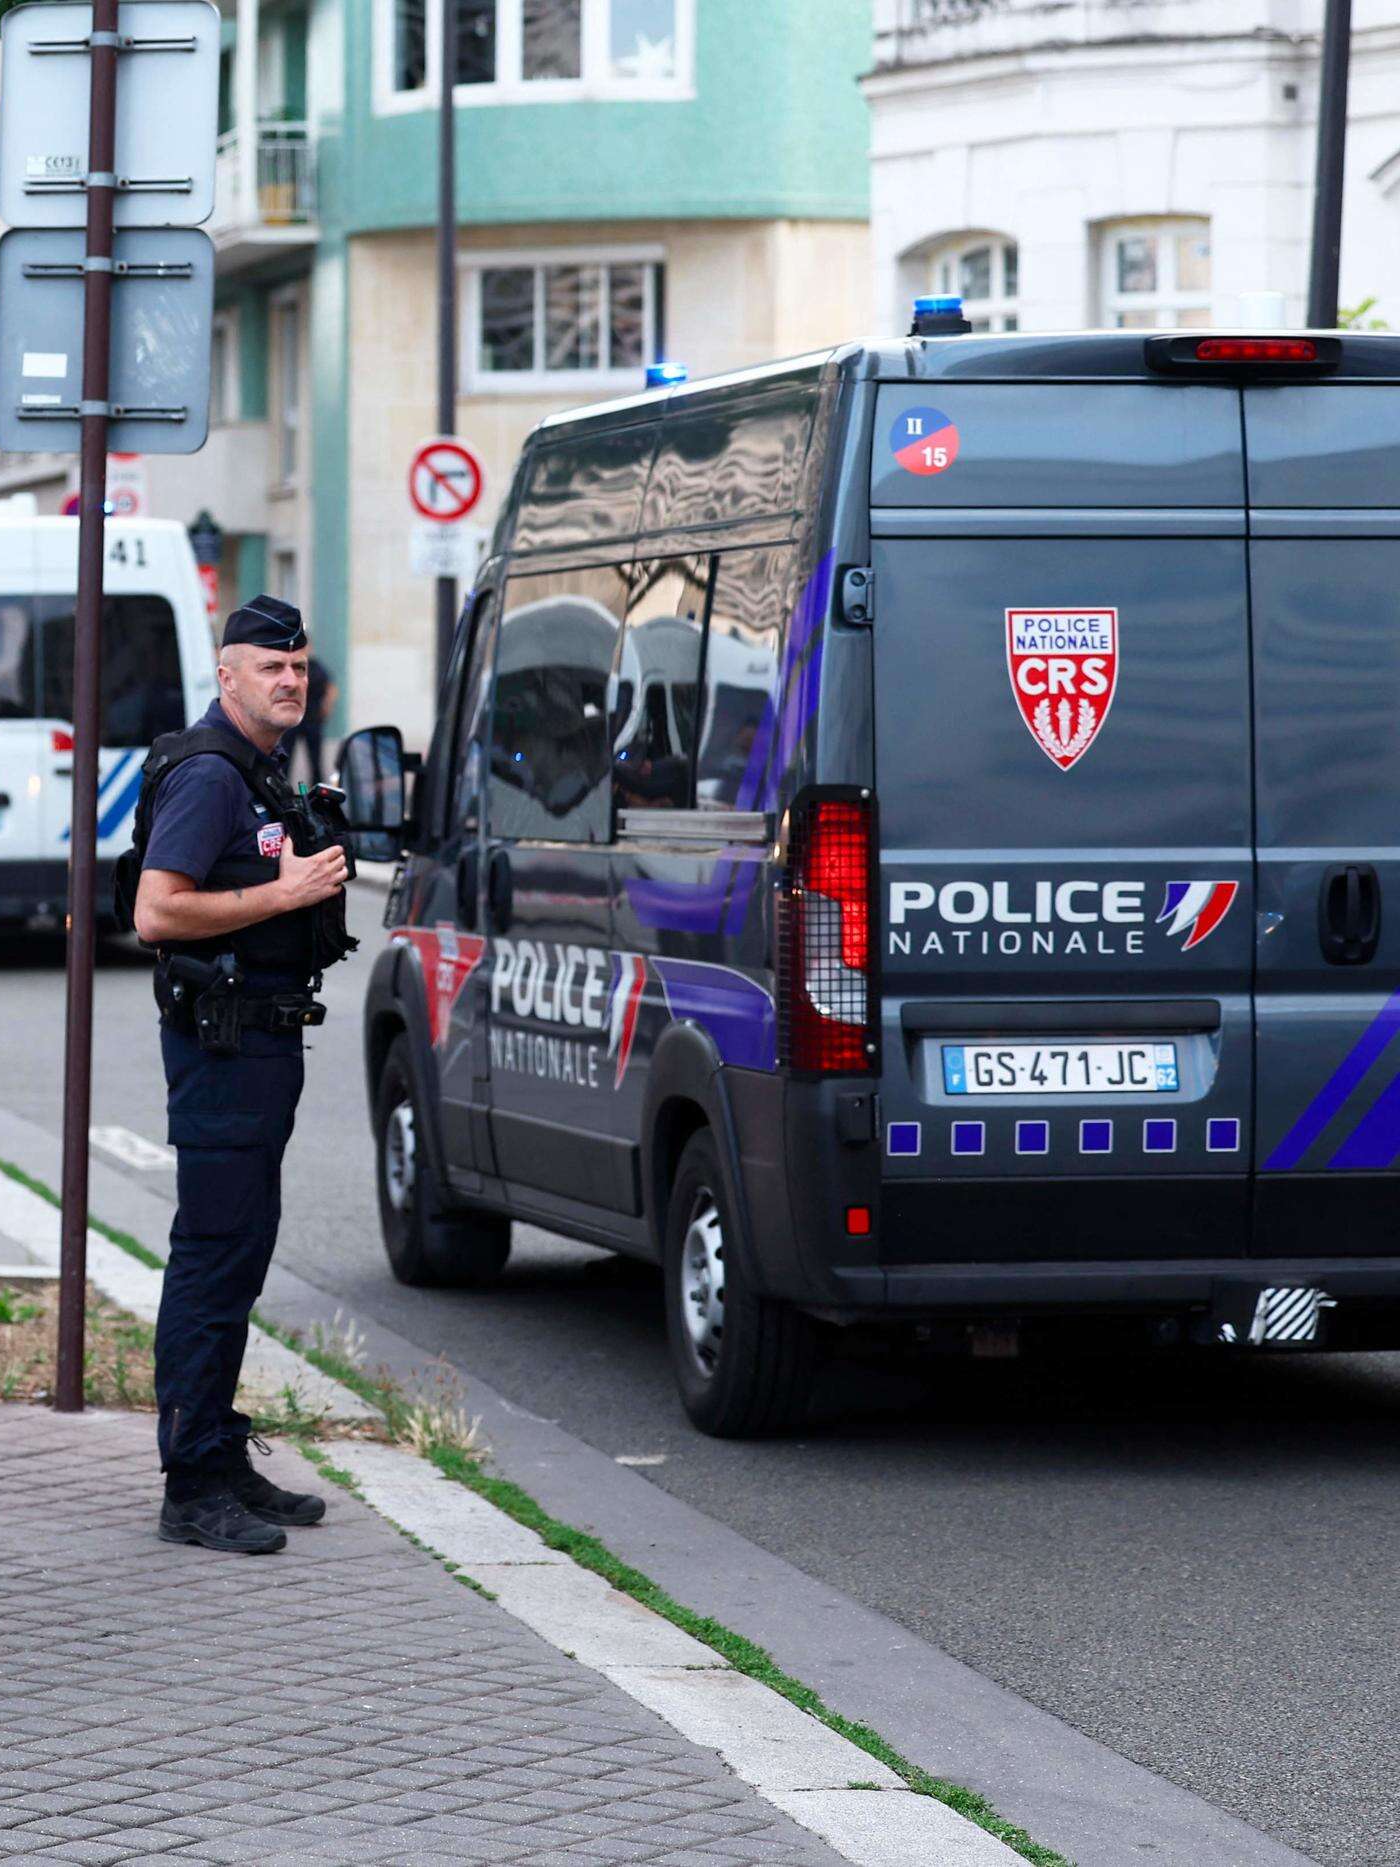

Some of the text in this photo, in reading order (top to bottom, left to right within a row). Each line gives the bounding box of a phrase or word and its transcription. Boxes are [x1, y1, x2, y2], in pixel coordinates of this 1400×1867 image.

[922, 447, 948, 468] 15
[1023, 618, 1101, 633] POLICE
[1016, 634, 1109, 651] NATIONALE
[1016, 658, 1110, 696] CRS
[888, 880, 1146, 924] POLICE
[888, 929, 1146, 955] NATIONALE
[492, 938, 606, 1027] POLICE
[490, 1029, 599, 1088] NATIONALE
[951, 1074, 961, 1086] F
[1157, 1067, 1178, 1086] 62
